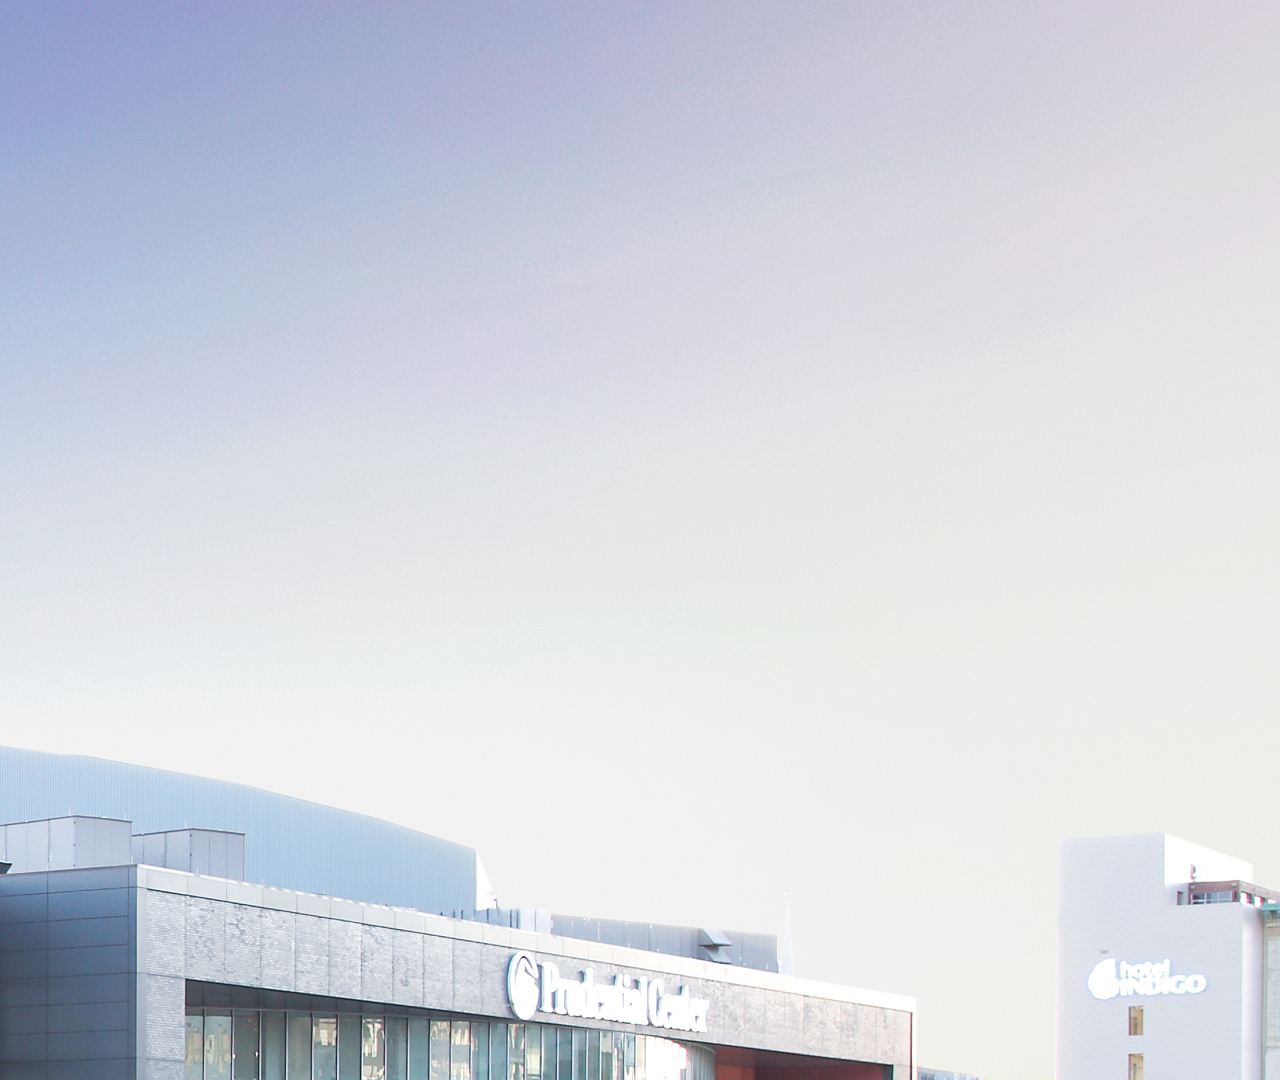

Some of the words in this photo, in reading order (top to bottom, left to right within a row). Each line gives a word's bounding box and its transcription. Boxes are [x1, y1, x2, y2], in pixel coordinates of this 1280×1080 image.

[1119, 958, 1171, 978] hotel
[1119, 974, 1207, 996] INDIGO
[538, 961, 649, 1026] Prudential
[648, 978, 710, 1033] Center
